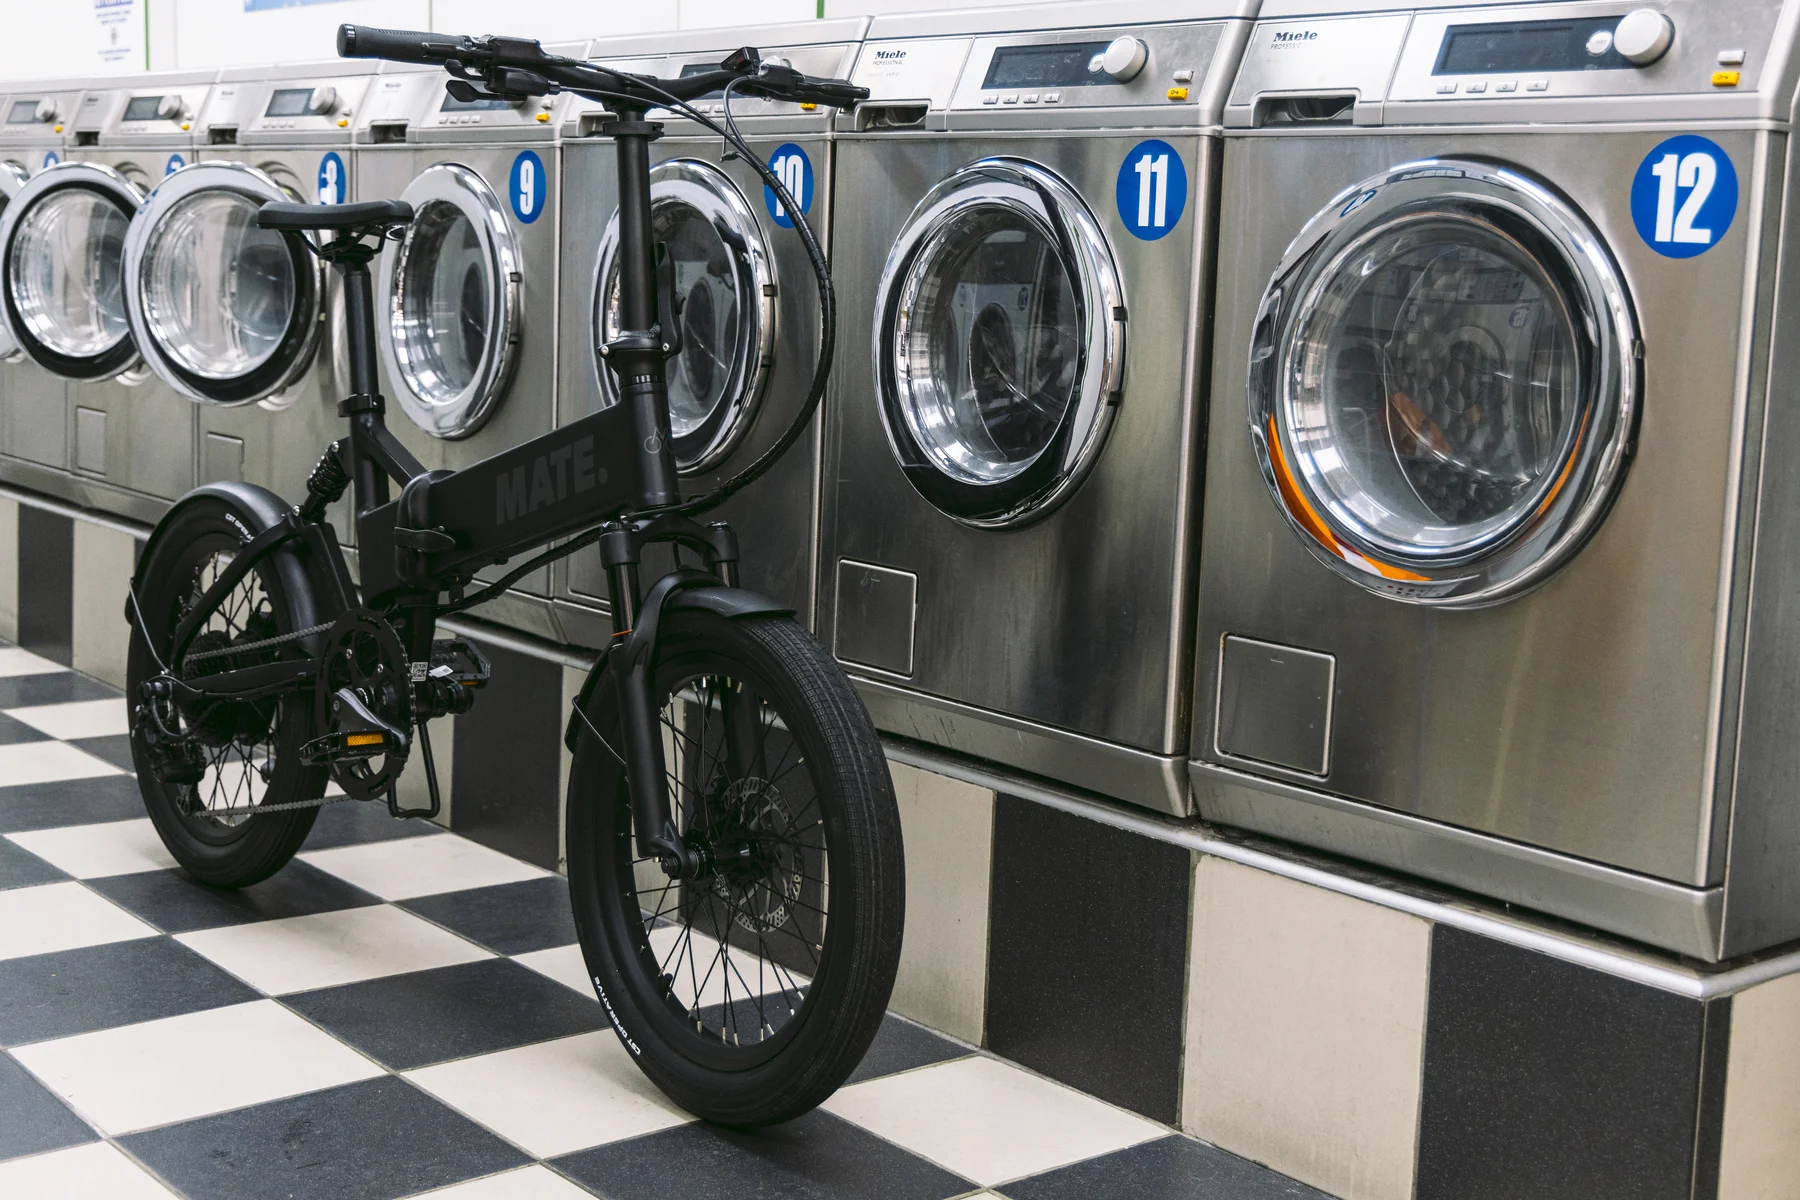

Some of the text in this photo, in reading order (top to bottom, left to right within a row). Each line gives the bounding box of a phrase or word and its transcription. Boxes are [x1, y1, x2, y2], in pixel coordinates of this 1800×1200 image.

[874, 50, 907, 60] Miele
[1273, 30, 1318, 42] Miele
[520, 159, 535, 215] 9
[773, 154, 804, 217] 10
[1134, 154, 1169, 227] 11
[1652, 152, 1717, 244] 12
[496, 434, 608, 526] MATE.
[594, 976, 641, 1056] CST OPERATIVE
